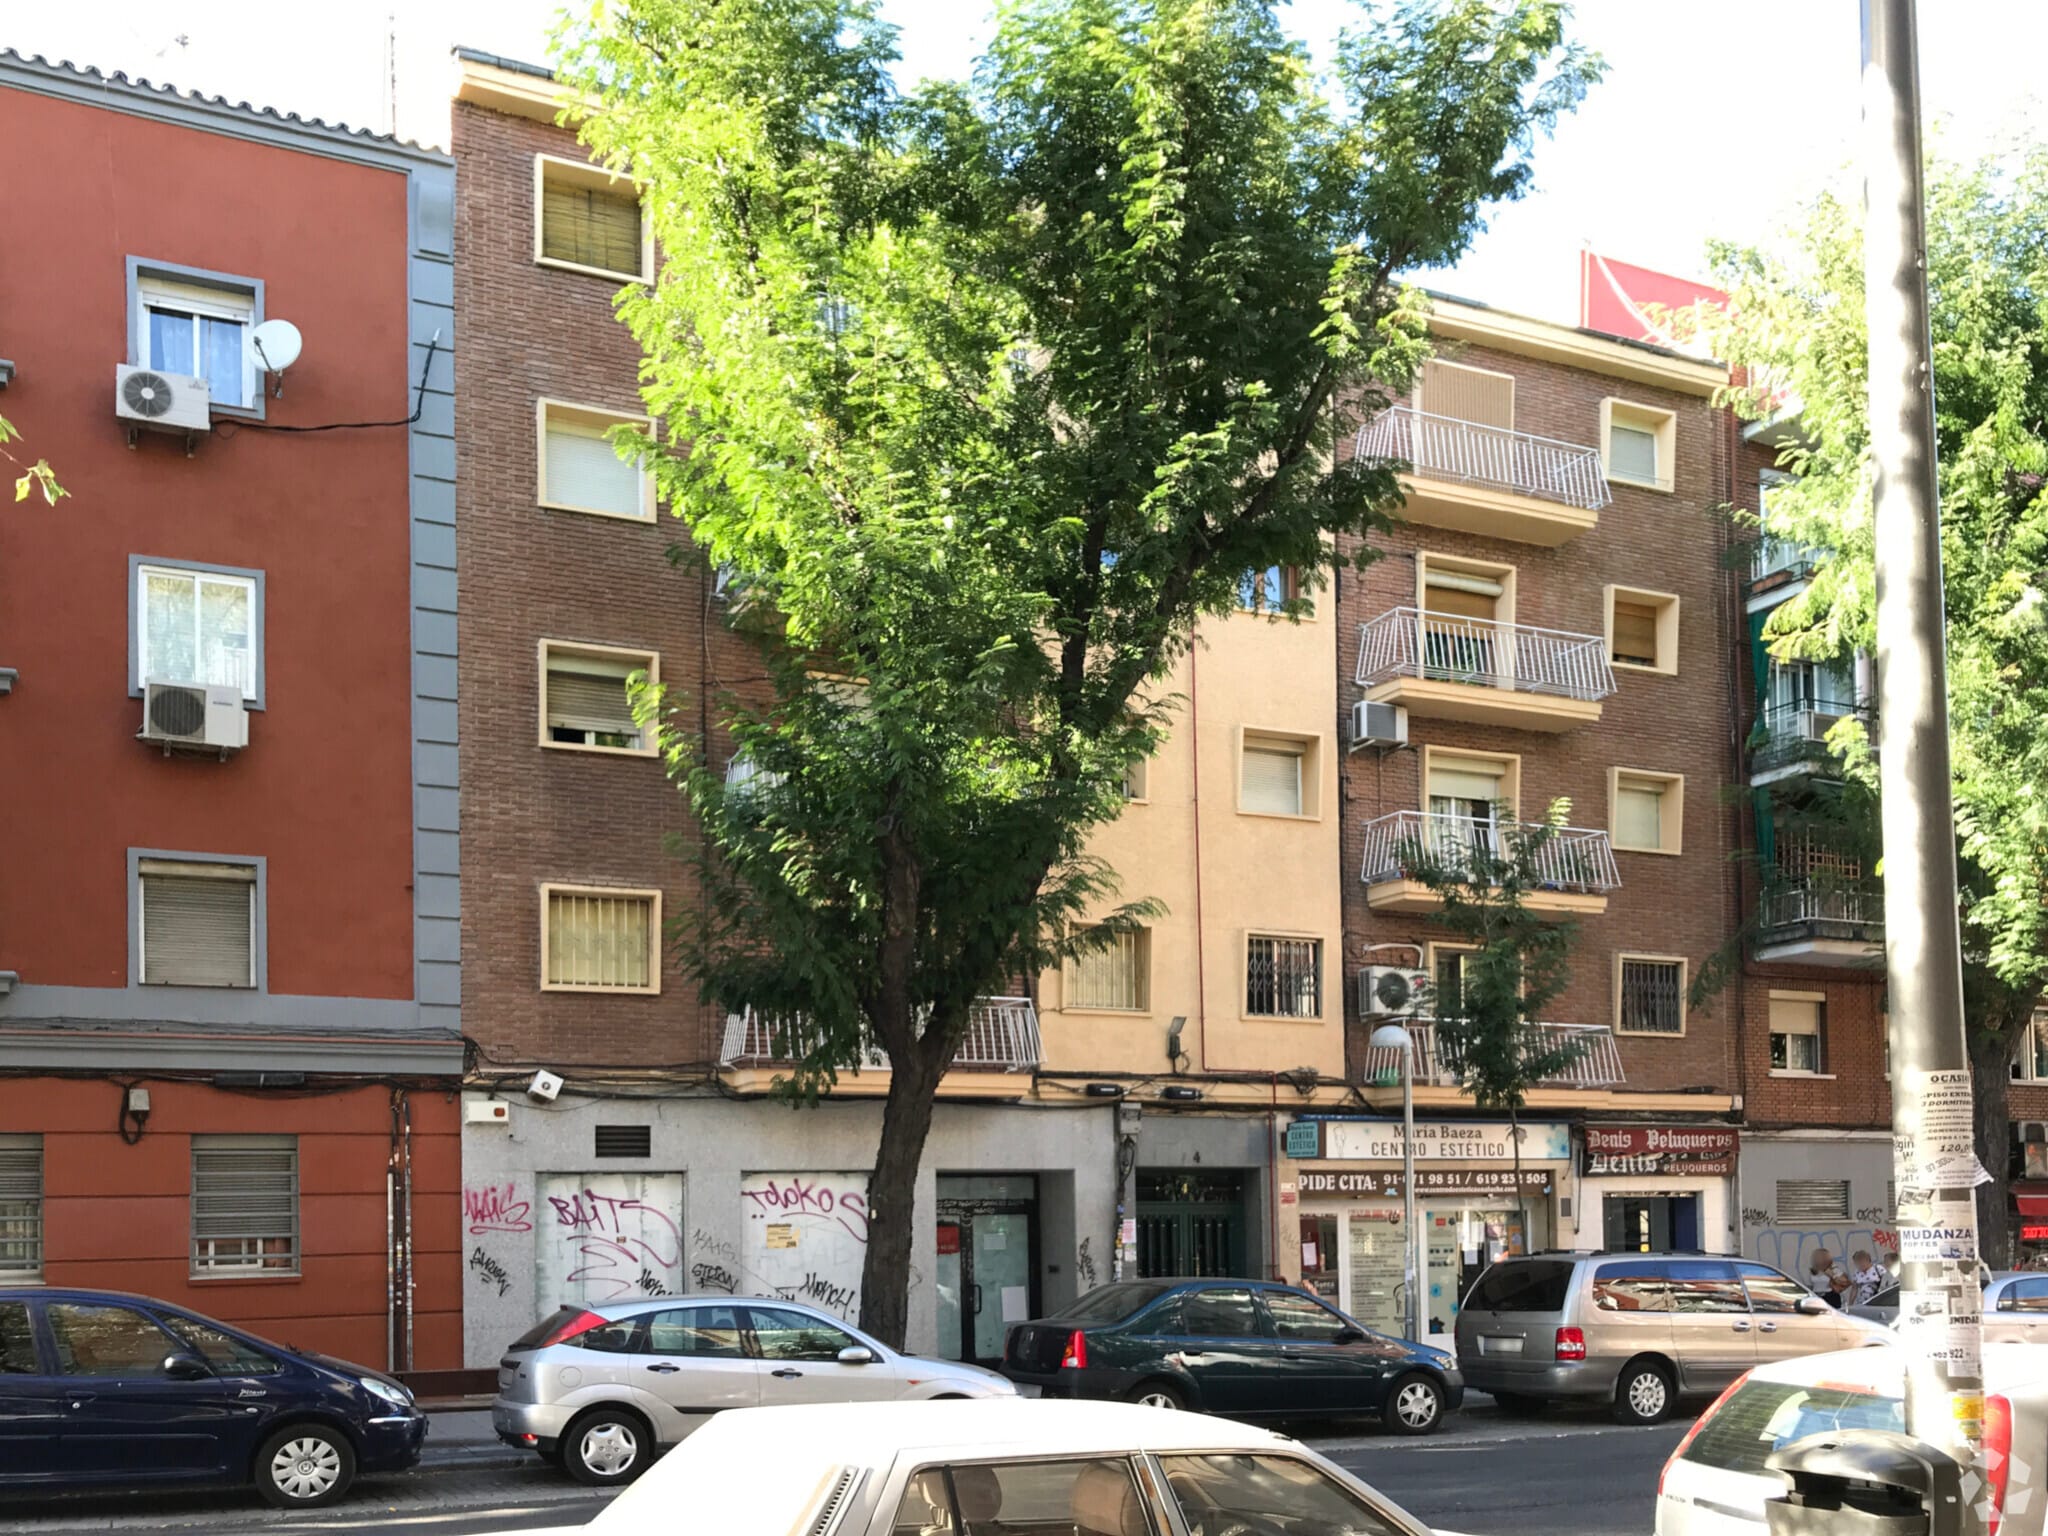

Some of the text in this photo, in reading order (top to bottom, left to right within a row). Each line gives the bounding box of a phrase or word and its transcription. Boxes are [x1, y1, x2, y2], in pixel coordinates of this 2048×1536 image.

[1440, 1125, 1483, 1139] Baeza
[1588, 1130, 1632, 1148] Denis
[1371, 1140, 1505, 1157] CENTRO ESTÉTICO
[1663, 1163, 1728, 1173] PELUQUEROS
[1299, 1174, 1335, 1190] PIDE
[1339, 1174, 1377, 1190] CITA:
[1428, 1174, 1444, 1185] 98
[1447, 1174, 1461, 1185] 51
[1476, 1173, 1499, 1185] 619
[1526, 1173, 1548, 1184] 505
[1902, 1228, 1974, 1240] MUDANZA
